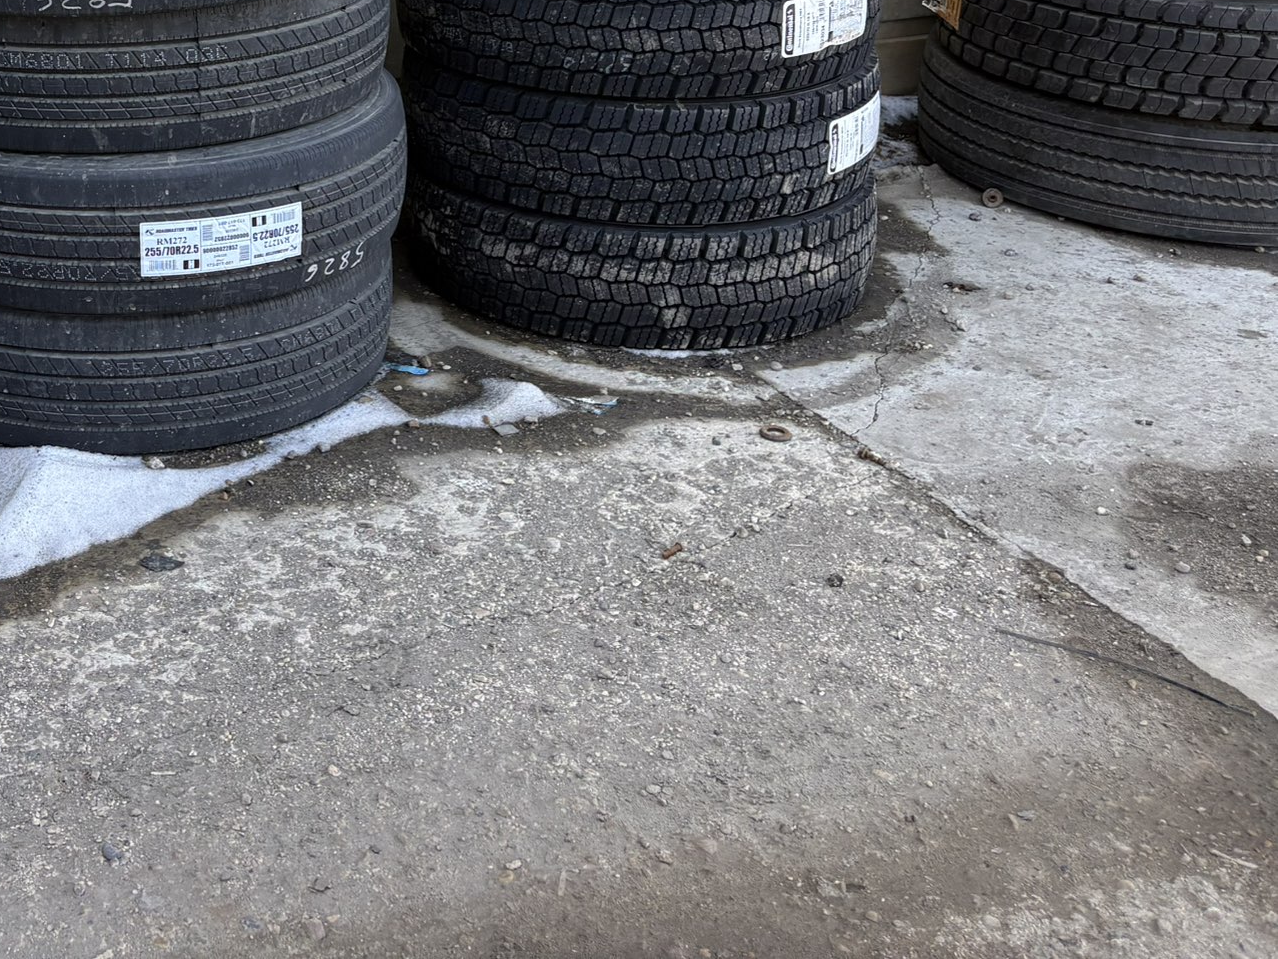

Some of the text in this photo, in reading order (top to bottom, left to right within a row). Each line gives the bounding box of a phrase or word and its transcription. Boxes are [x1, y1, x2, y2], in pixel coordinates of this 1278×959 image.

[252, 224, 300, 242] 255/70R22.5
[156, 236, 188, 246] RM272
[263, 236, 291, 249] RM272
[144, 245, 200, 257] 255/70R22.5
[305, 240, 365, 283] 5826
